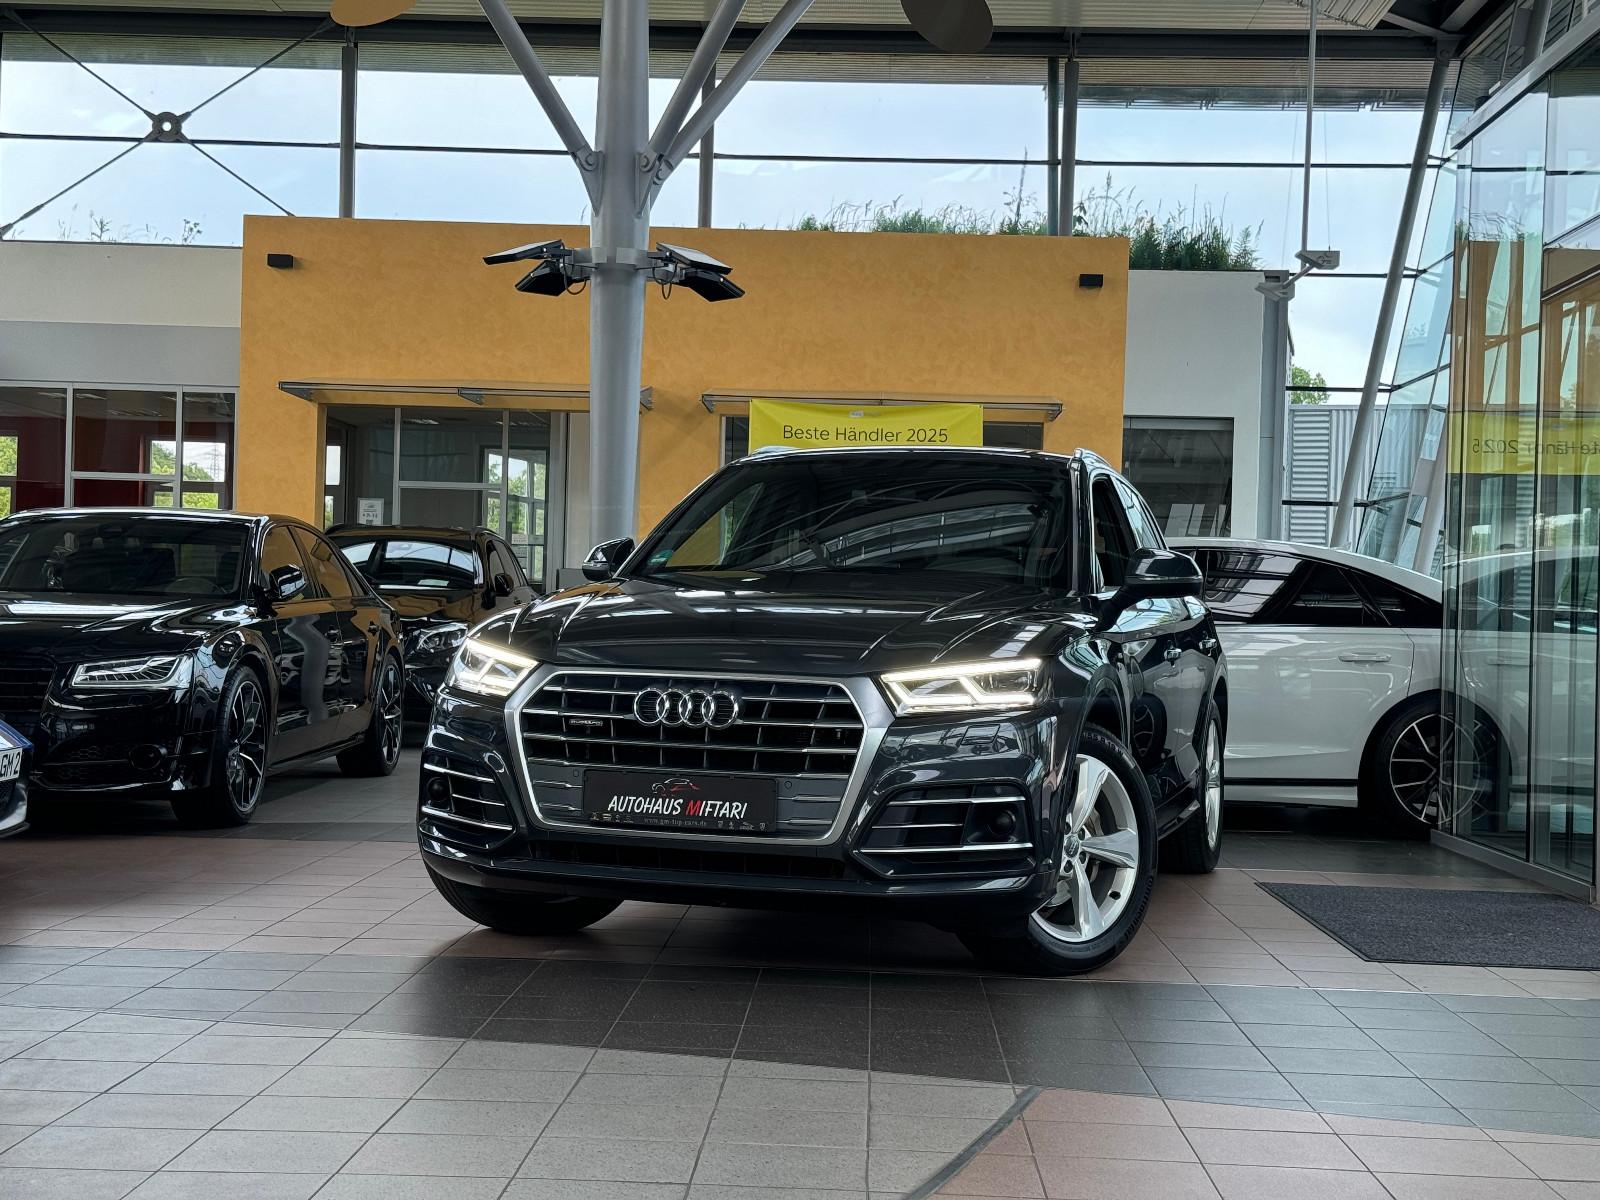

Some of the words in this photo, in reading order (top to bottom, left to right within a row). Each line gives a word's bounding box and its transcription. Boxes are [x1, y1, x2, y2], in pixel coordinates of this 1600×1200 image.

[783, 425, 830, 441] Beste
[835, 426, 902, 443] Händler
[906, 428, 948, 443] 2025
[607, 795, 683, 815] AUTOHAUS
[685, 799, 748, 820] MIFTARI
